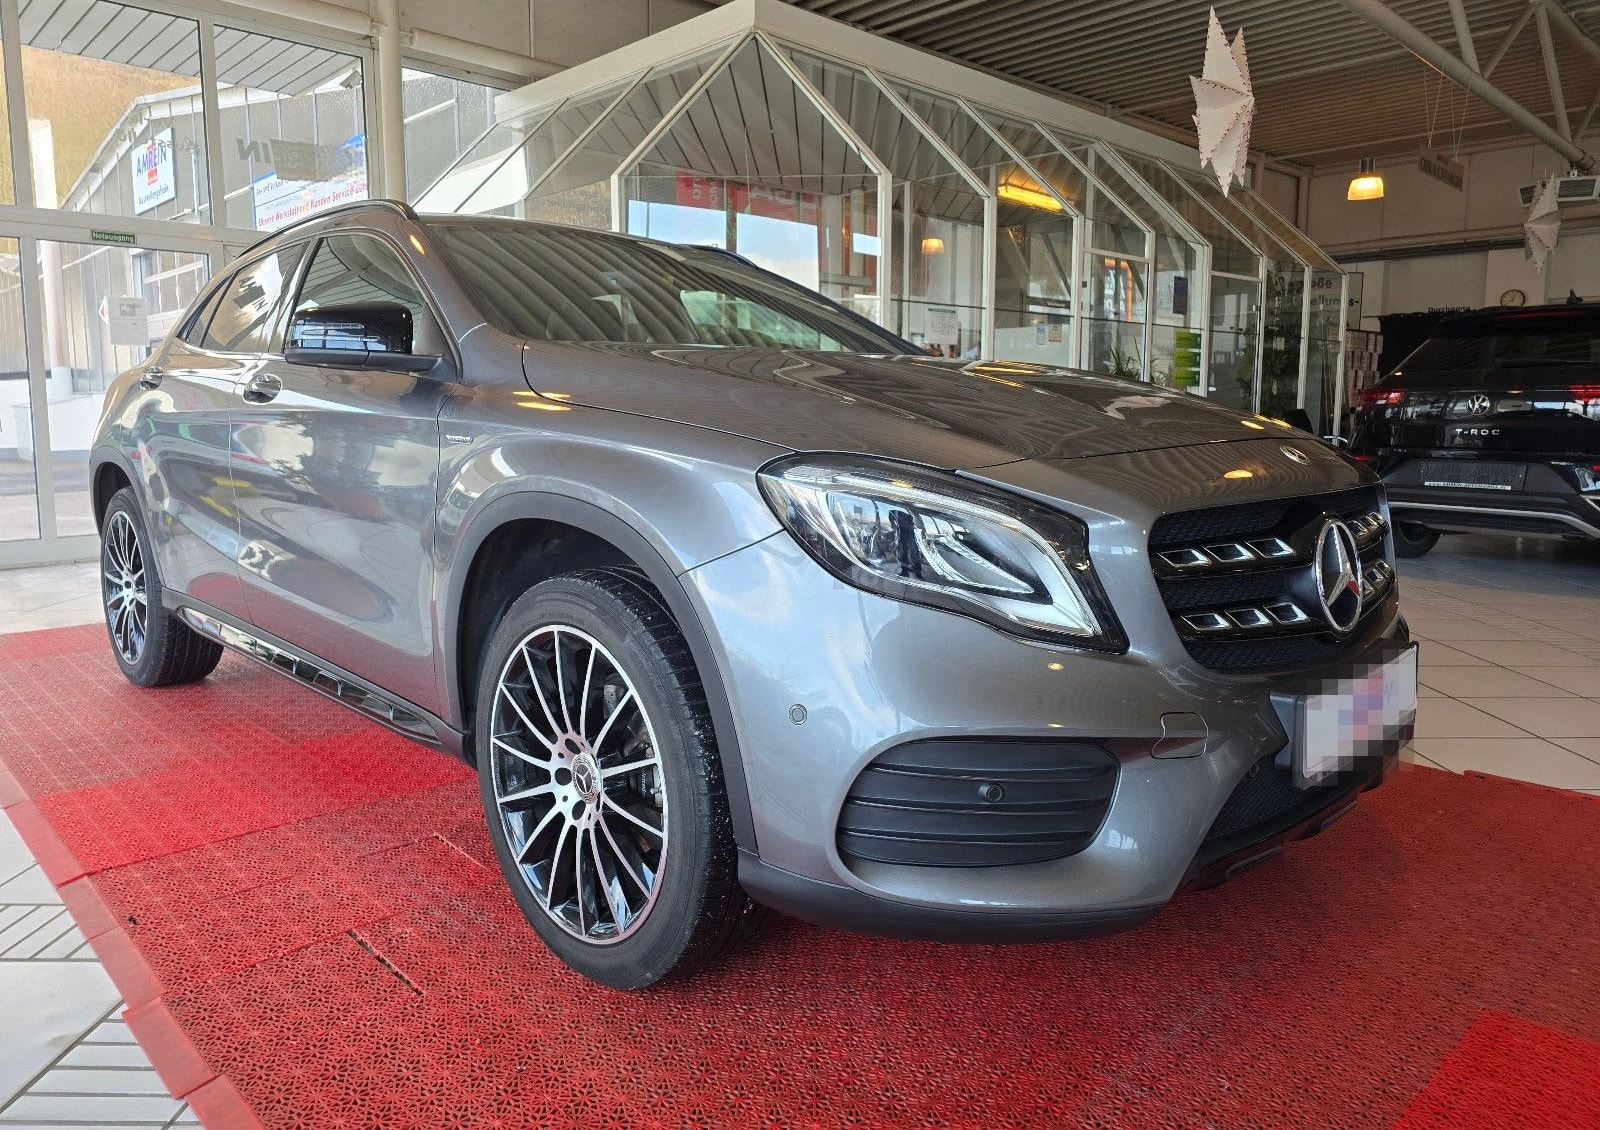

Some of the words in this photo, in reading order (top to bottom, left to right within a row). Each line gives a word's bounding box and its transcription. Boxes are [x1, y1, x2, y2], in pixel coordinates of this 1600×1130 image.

[136, 141, 167, 177] AMREIN
[92, 231, 134, 242] Notausgang
[1455, 428, 1500, 436] T-ROC
